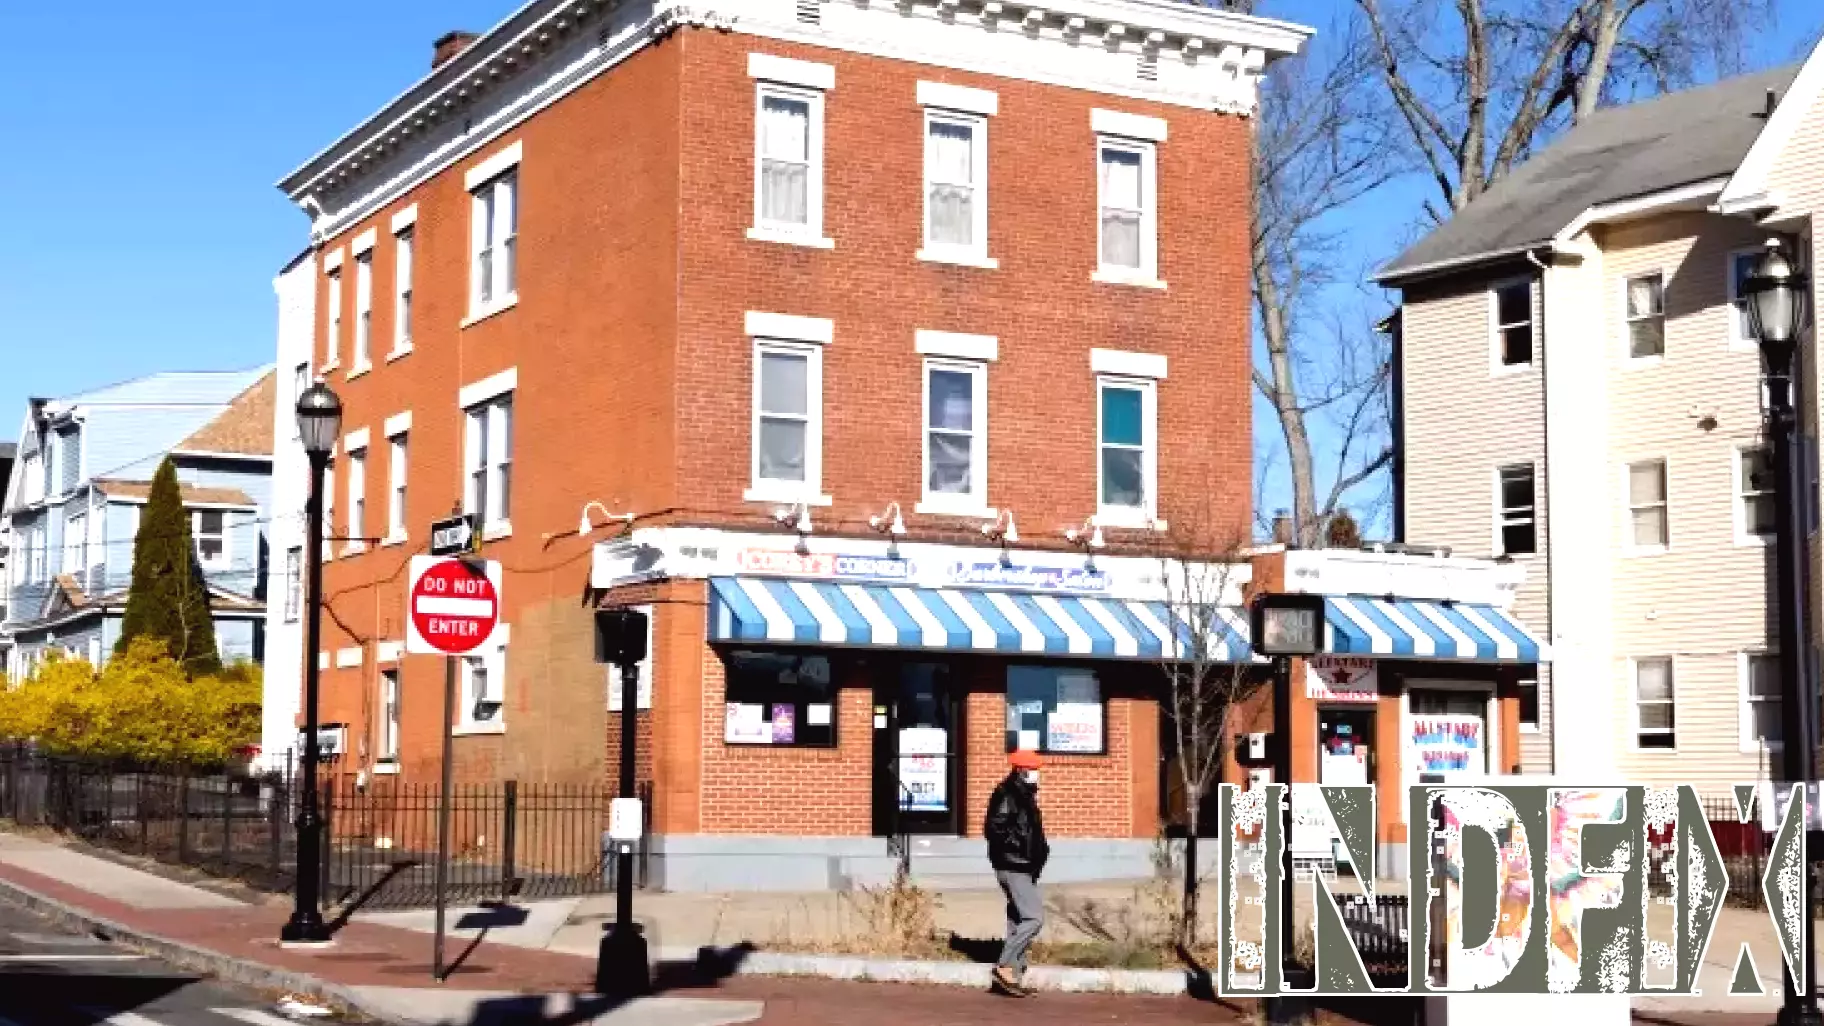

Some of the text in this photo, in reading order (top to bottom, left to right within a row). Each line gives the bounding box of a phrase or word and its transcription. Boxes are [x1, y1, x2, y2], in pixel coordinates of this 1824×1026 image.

[424, 577, 487, 595] DO NOT
[428, 618, 479, 636] ENTER
